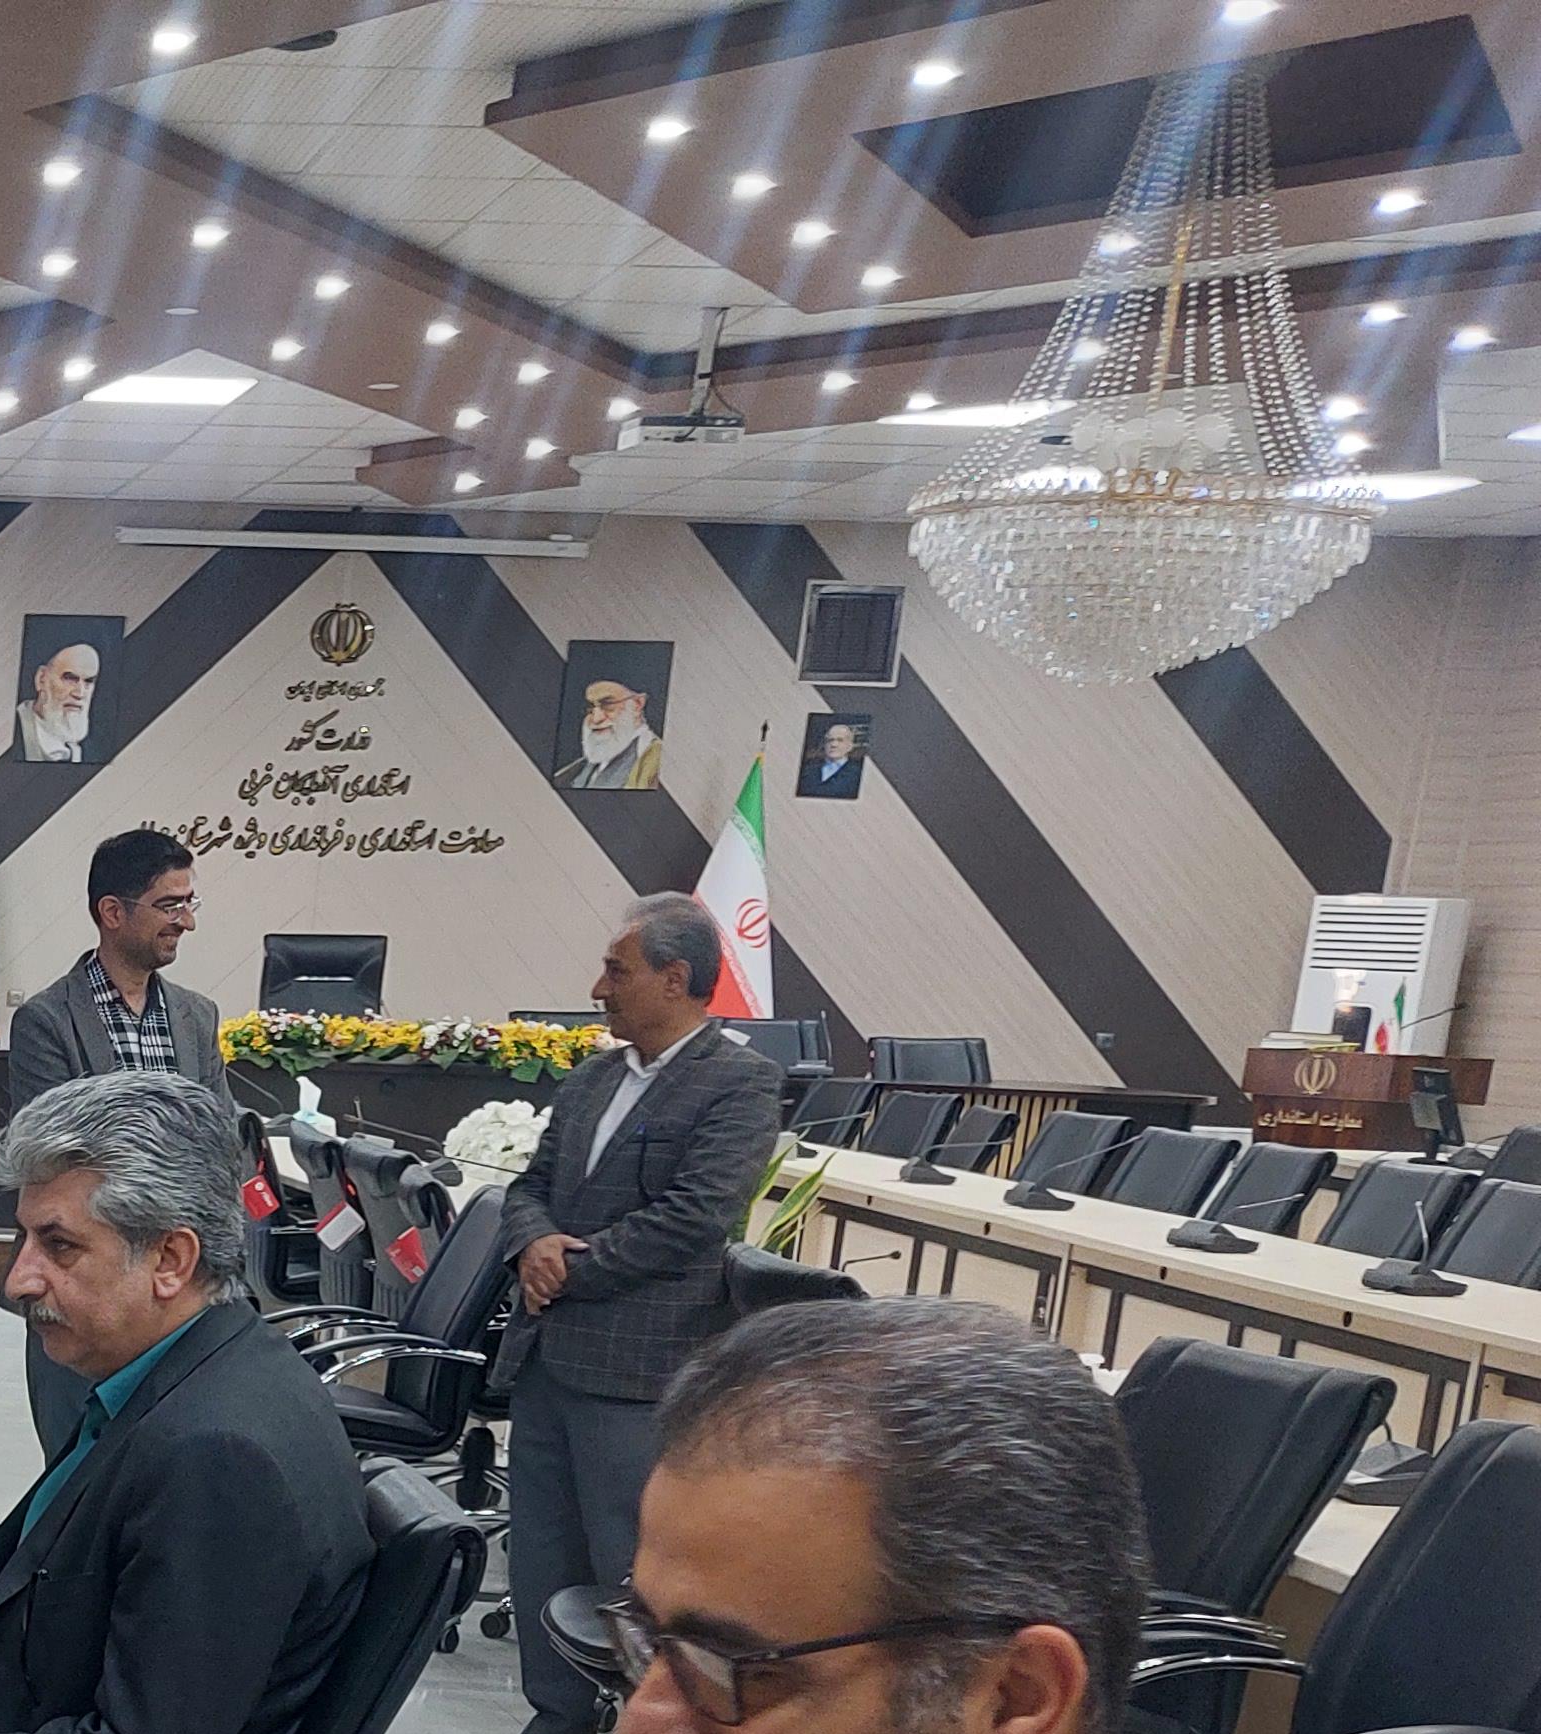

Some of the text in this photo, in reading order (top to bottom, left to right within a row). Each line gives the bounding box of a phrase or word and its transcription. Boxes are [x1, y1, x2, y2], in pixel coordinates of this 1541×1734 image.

[284, 709, 372, 752] وزارت کشور
[238, 763, 411, 806] استانداری آذربایجان غربی
[233, 816, 268, 859] ویژه
[269, 817, 346, 858] فرمانداری
[344, 833, 356, 851] و
[357, 819, 438, 858] استانداری
[439, 825, 505, 853] معاونت
[1258, 1108, 1363, 1132] معاونت استانداری
